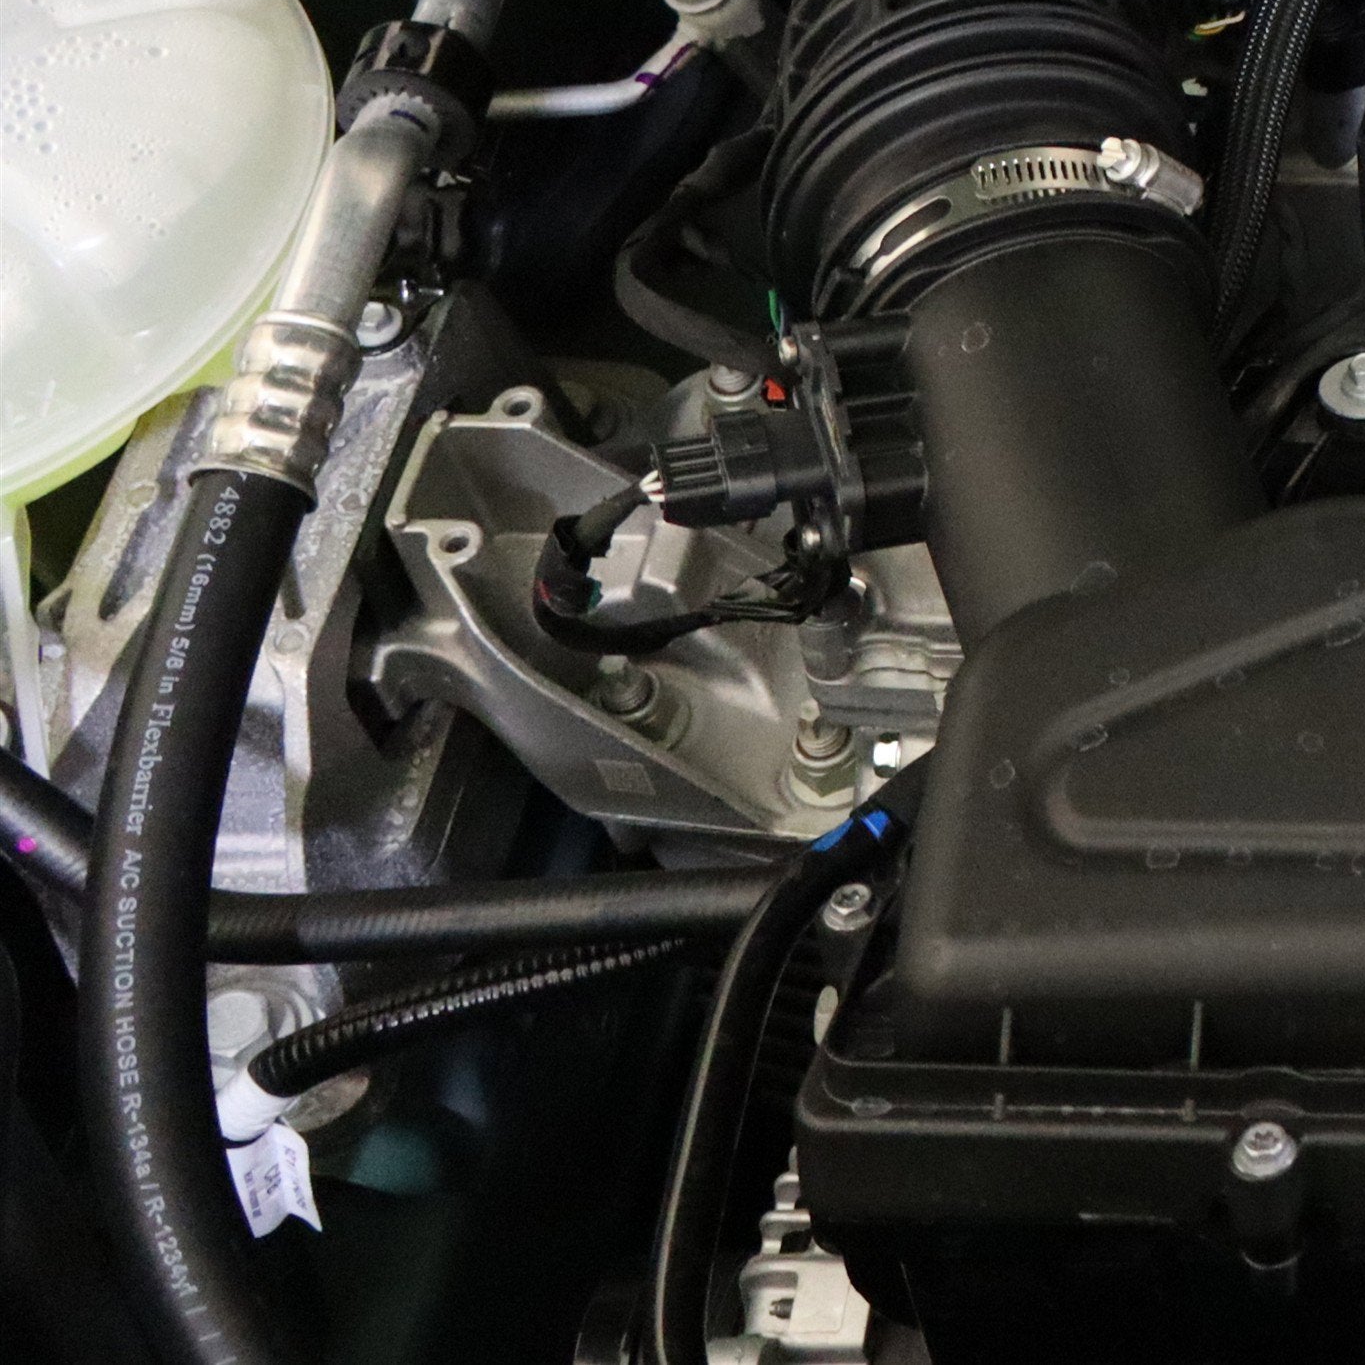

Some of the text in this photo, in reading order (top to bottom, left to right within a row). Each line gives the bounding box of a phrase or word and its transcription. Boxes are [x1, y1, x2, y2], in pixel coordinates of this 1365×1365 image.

[202, 483, 242, 548] 4882
[173, 550, 216, 634] (16mm)
[157, 673, 180, 697] in
[162, 633, 192, 673] 5/8
[121, 698, 177, 837] Flexbarrier
[118, 848, 143, 891] A/C
[113, 895, 138, 1009] SUCTION
[112, 1016, 142, 1087] HOSE
[118, 1091, 158, 1179] R-134a
